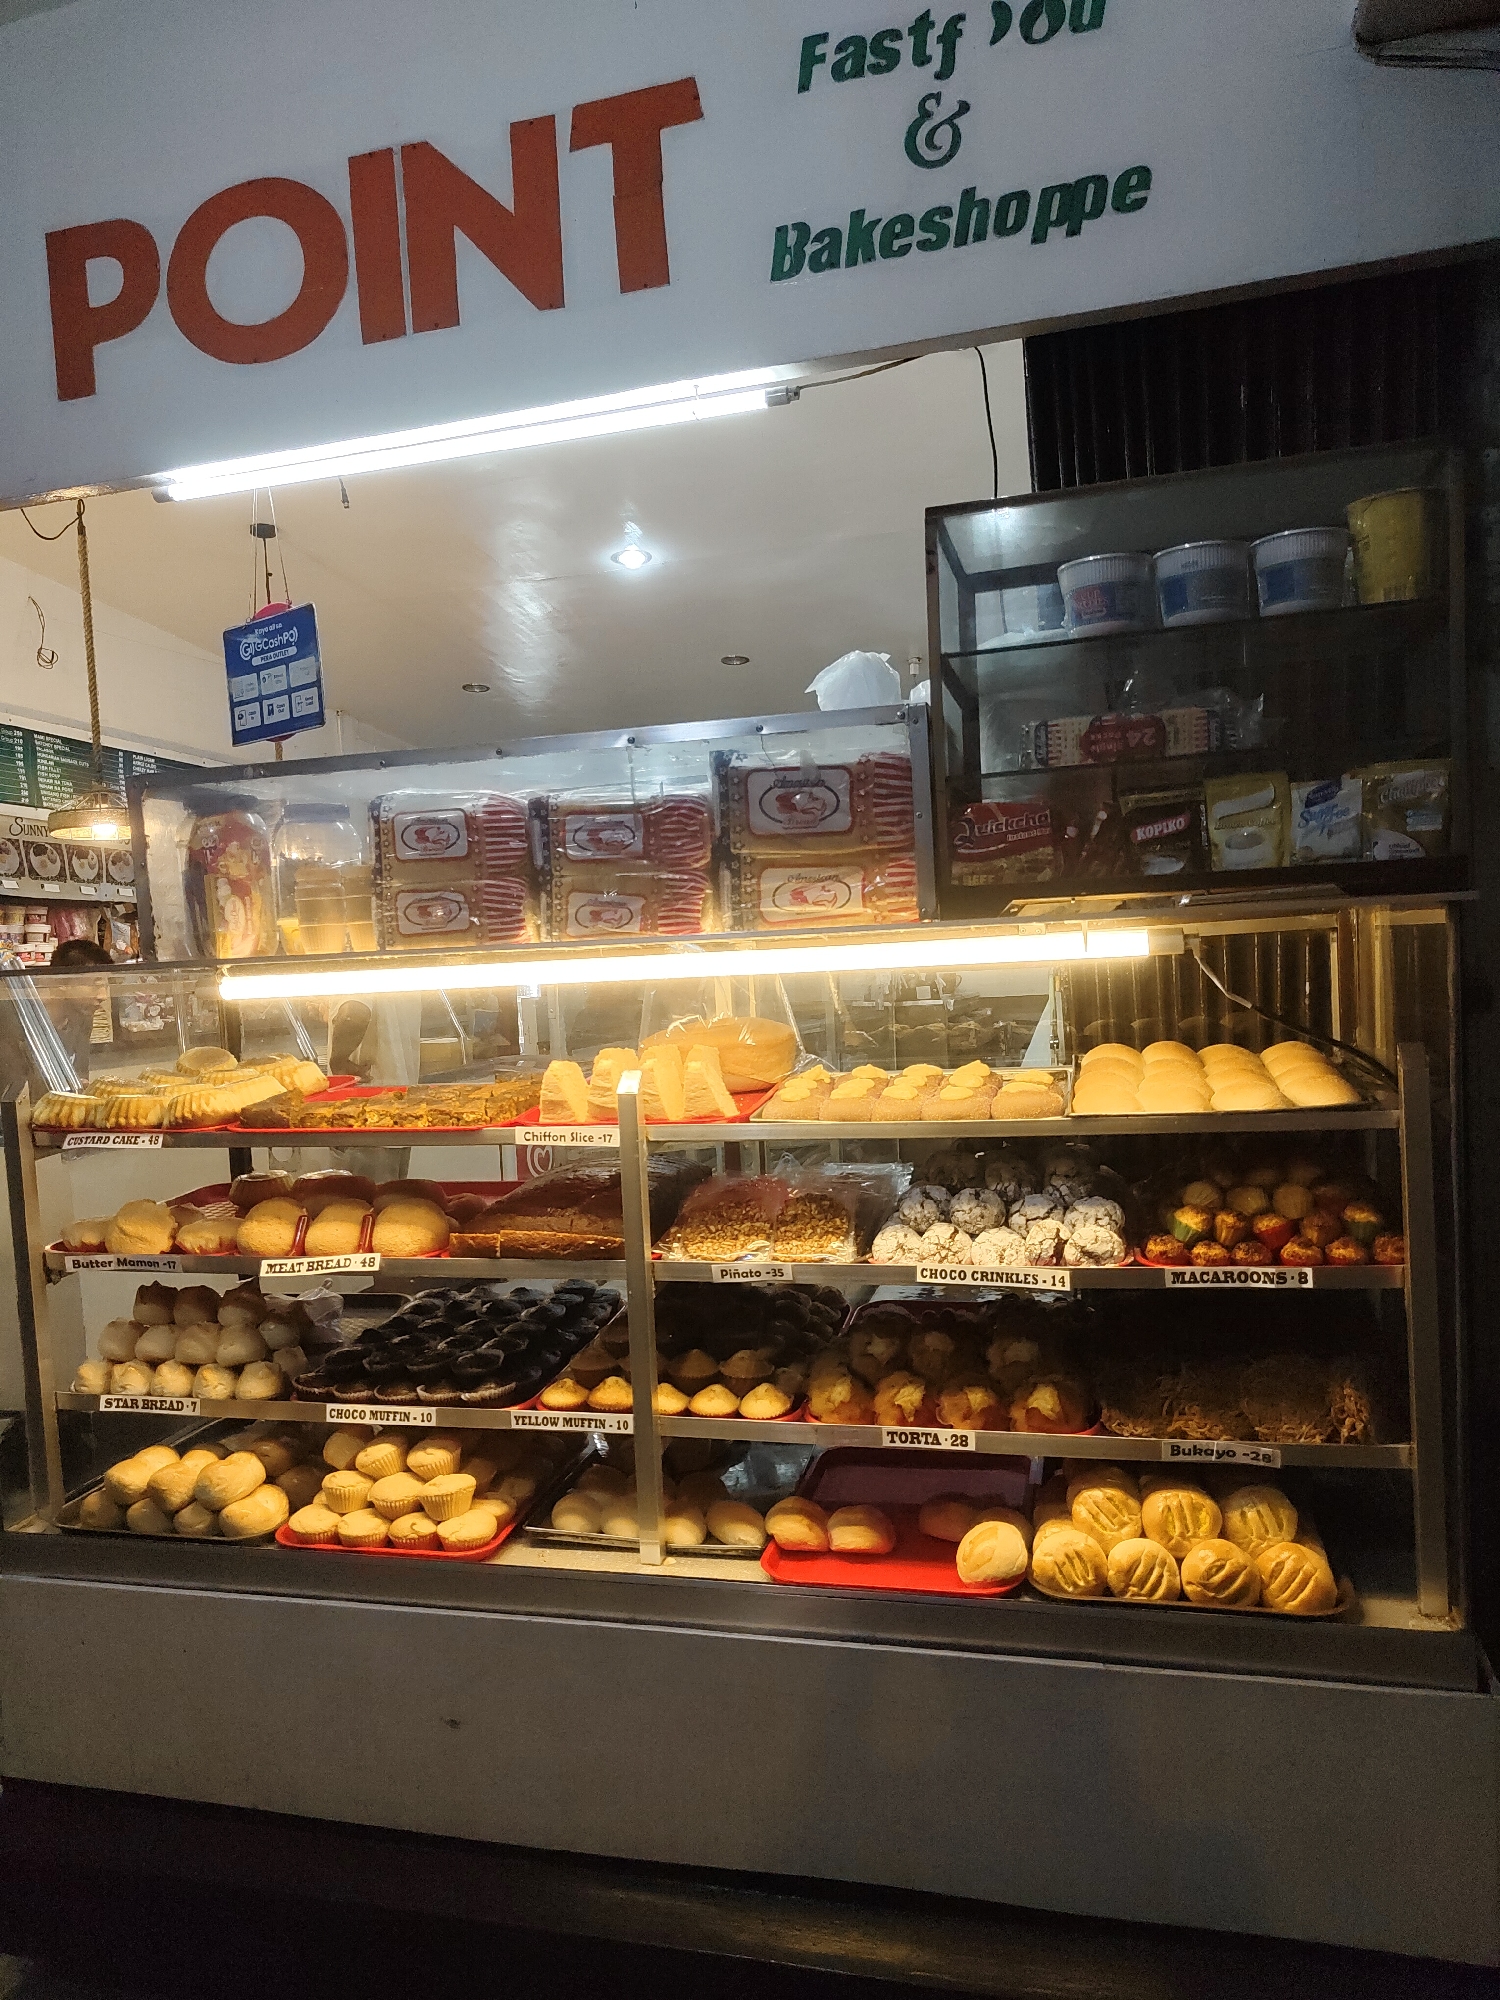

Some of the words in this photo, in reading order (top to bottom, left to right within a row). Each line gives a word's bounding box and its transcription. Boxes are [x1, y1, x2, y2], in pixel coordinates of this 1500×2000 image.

[904, 91, 971, 169] &
[770, 164, 1152, 283] Bakeshoppe
[46, 76, 703, 401] POINT
[1126, 727, 1155, 748] 24
[1136, 817, 1185, 841] KOPIKO
[67, 1135, 110, 1146] CUSTARD
[112, 1135, 140, 1145] CAKE
[148, 1135, 159, 1145] 48
[523, 1131, 566, 1143] Chiffon
[570, 1131, 594, 1143] Slice
[72, 1258, 113, 1270] Butter
[116, 1257, 160, 1269] Mamon
[265, 1261, 304, 1274] MEAT
[306, 1257, 351, 1272] BREAD
[360, 1257, 376, 1268] 48
[720, 1268, 762, 1280] Piñato
[920, 1268, 967, 1281] CHOCO
[971, 1270, 1039, 1286] CRINKLES
[1051, 1274, 1066, 1288] 14
[1171, 1271, 1288, 1285] MACAROONS
[1298, 1271, 1308, 1285] 8
[104, 1397, 139, 1410] STAR
[141, 1398, 184, 1412] BREAD
[191, 1401, 197, 1412] 7
[329, 1408, 367, 1420] CHOCO
[369, 1410, 411, 1422] MUFFIN
[420, 1412, 432, 1423] 10
[514, 1415, 560, 1427] YELLOW
[562, 1417, 606, 1429] MUFFIN
[617, 1420, 629, 1430] 10
[886, 1431, 942, 1445] TORTA
[950, 1433, 969, 1447] 28
[1170, 1444, 1237, 1459] Bukayo
